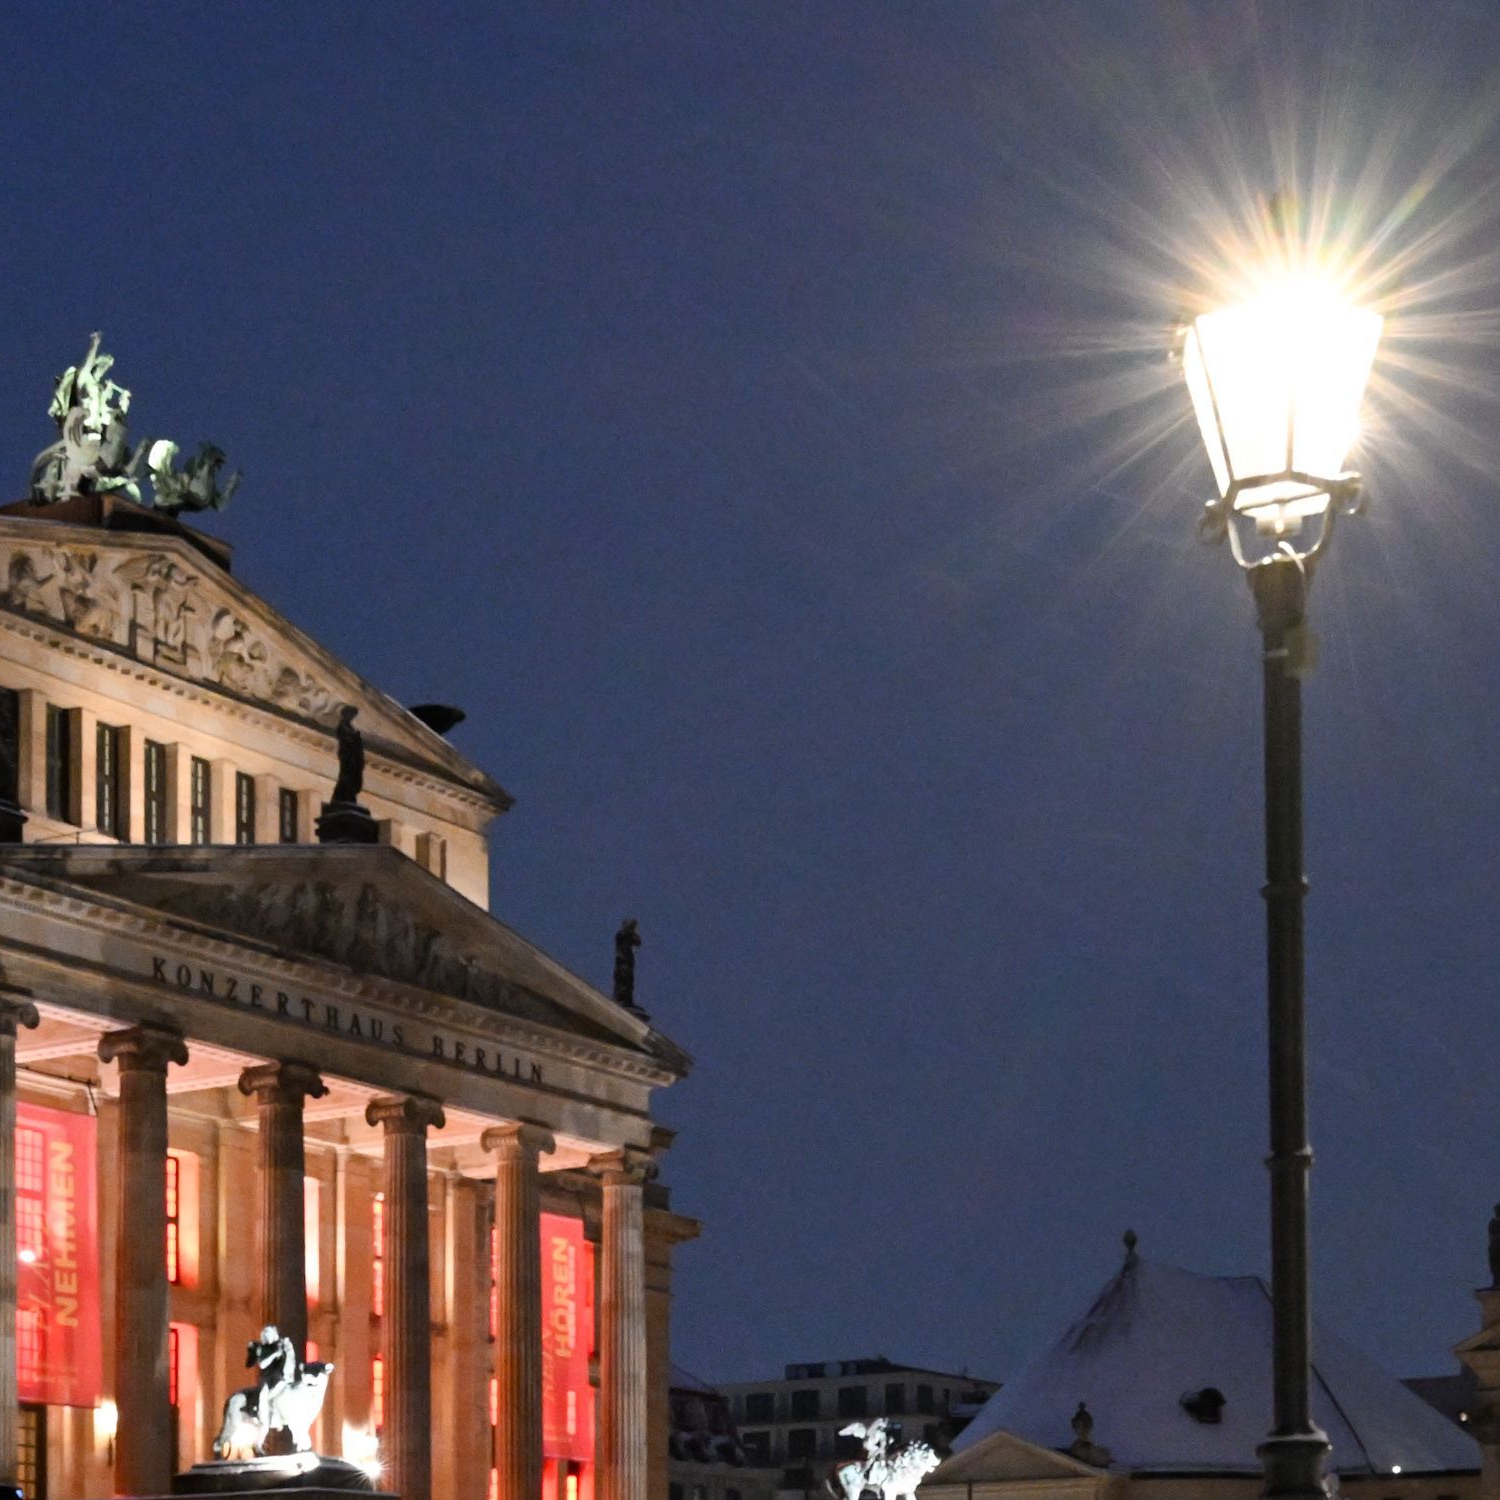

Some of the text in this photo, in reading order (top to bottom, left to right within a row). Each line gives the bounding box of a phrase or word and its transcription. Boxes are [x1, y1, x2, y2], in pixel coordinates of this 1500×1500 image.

[152, 957, 543, 1084] KONZERTHAUS BERLIN
[50, 1141, 79, 1328] NEHMEN
[551, 1236, 572, 1358] HÖREN
